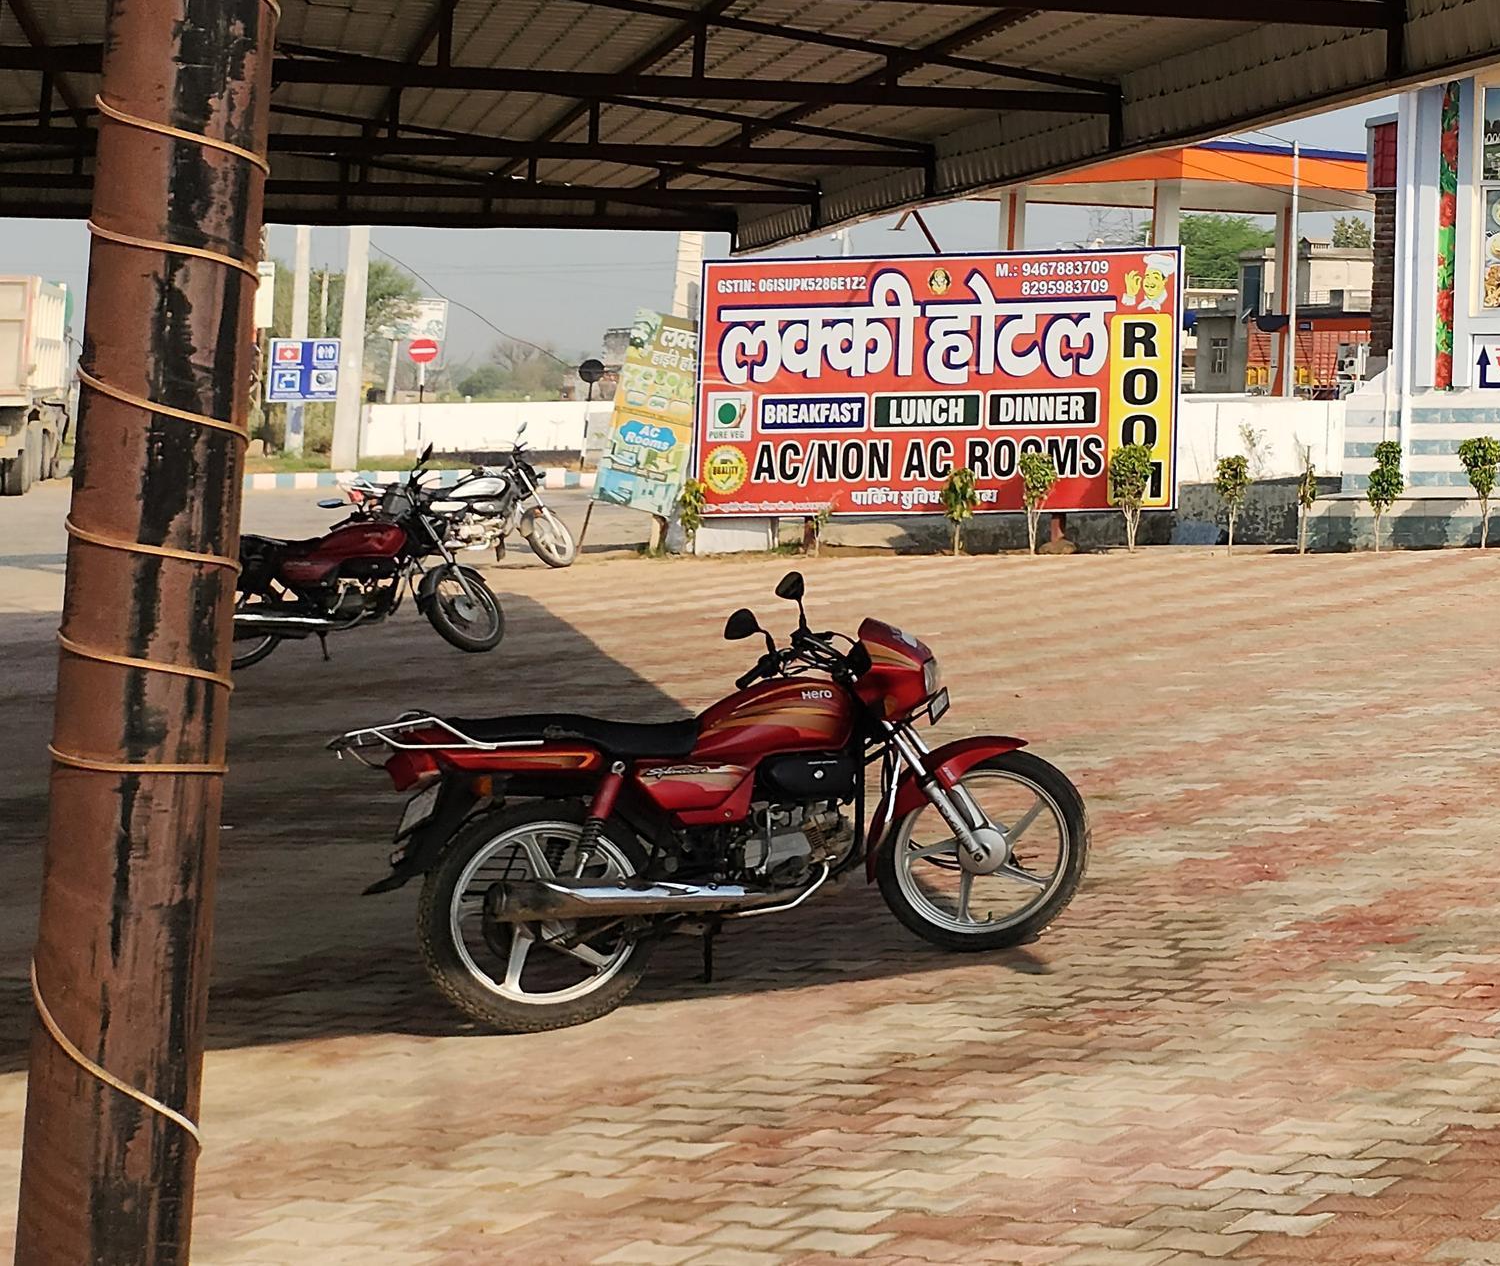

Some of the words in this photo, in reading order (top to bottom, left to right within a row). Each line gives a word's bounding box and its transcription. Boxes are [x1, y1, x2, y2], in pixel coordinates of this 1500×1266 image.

[1021, 260, 1109, 277] 9467883709
[717, 278, 755, 293] GSTIN:
[1021, 279, 1109, 295] 8295983709
[718, 267, 923, 384] लक्की
[925, 268, 1117, 384] होटल
[764, 402, 862, 424] BREAKFAST
[889, 397, 965, 424] LUNCH
[1000, 395, 1086, 422] DINNER
[625, 433, 670, 451] Rooms
[639, 428, 660, 438] AC
[753, 440, 889, 486] AC/NON
[904, 439, 952, 481] AC
[900, 487, 943, 509] सुविध
[802, 690, 833, 700] Hero
